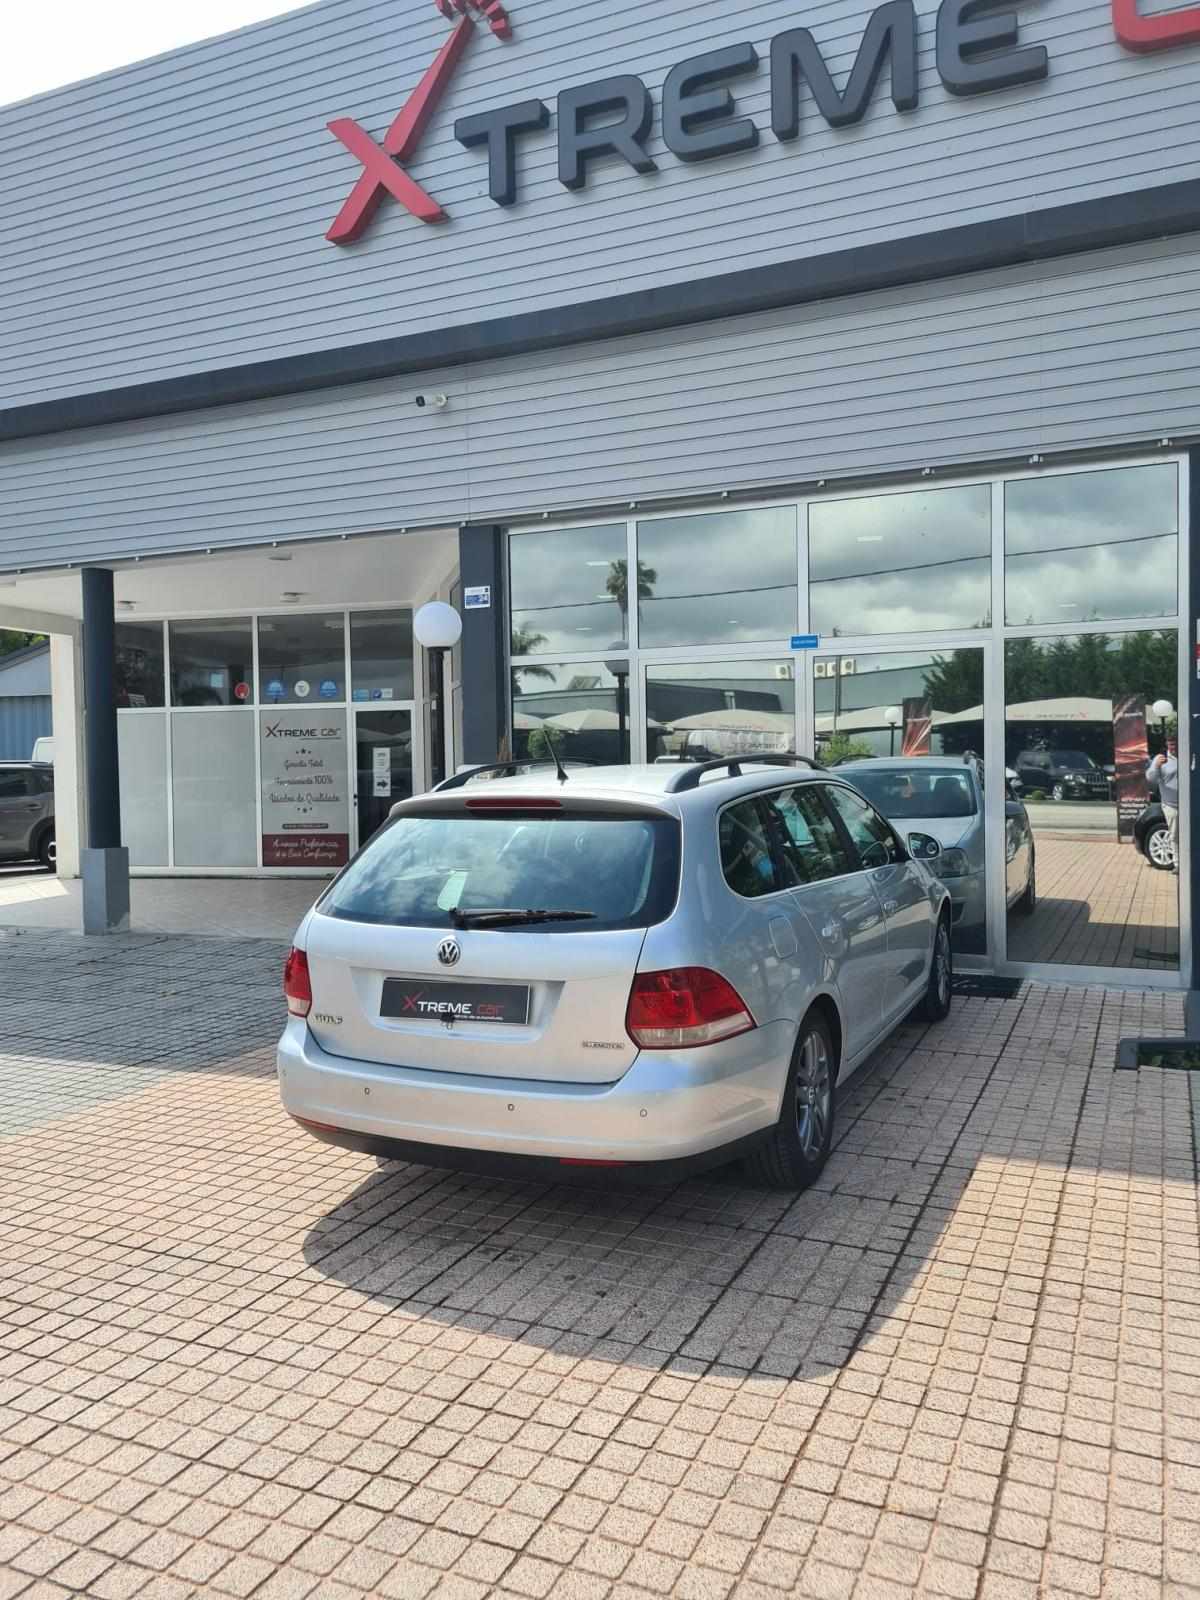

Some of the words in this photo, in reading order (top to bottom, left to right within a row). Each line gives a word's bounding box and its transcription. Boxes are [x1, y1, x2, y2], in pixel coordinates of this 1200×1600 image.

[326, 0, 1049, 246] XTREME
[265, 721, 318, 738] XTREME
[320, 728, 342, 736] car
[314, 775, 333, 785] 100%
[402, 991, 472, 1014] XTREME
[478, 1003, 504, 1015] car
